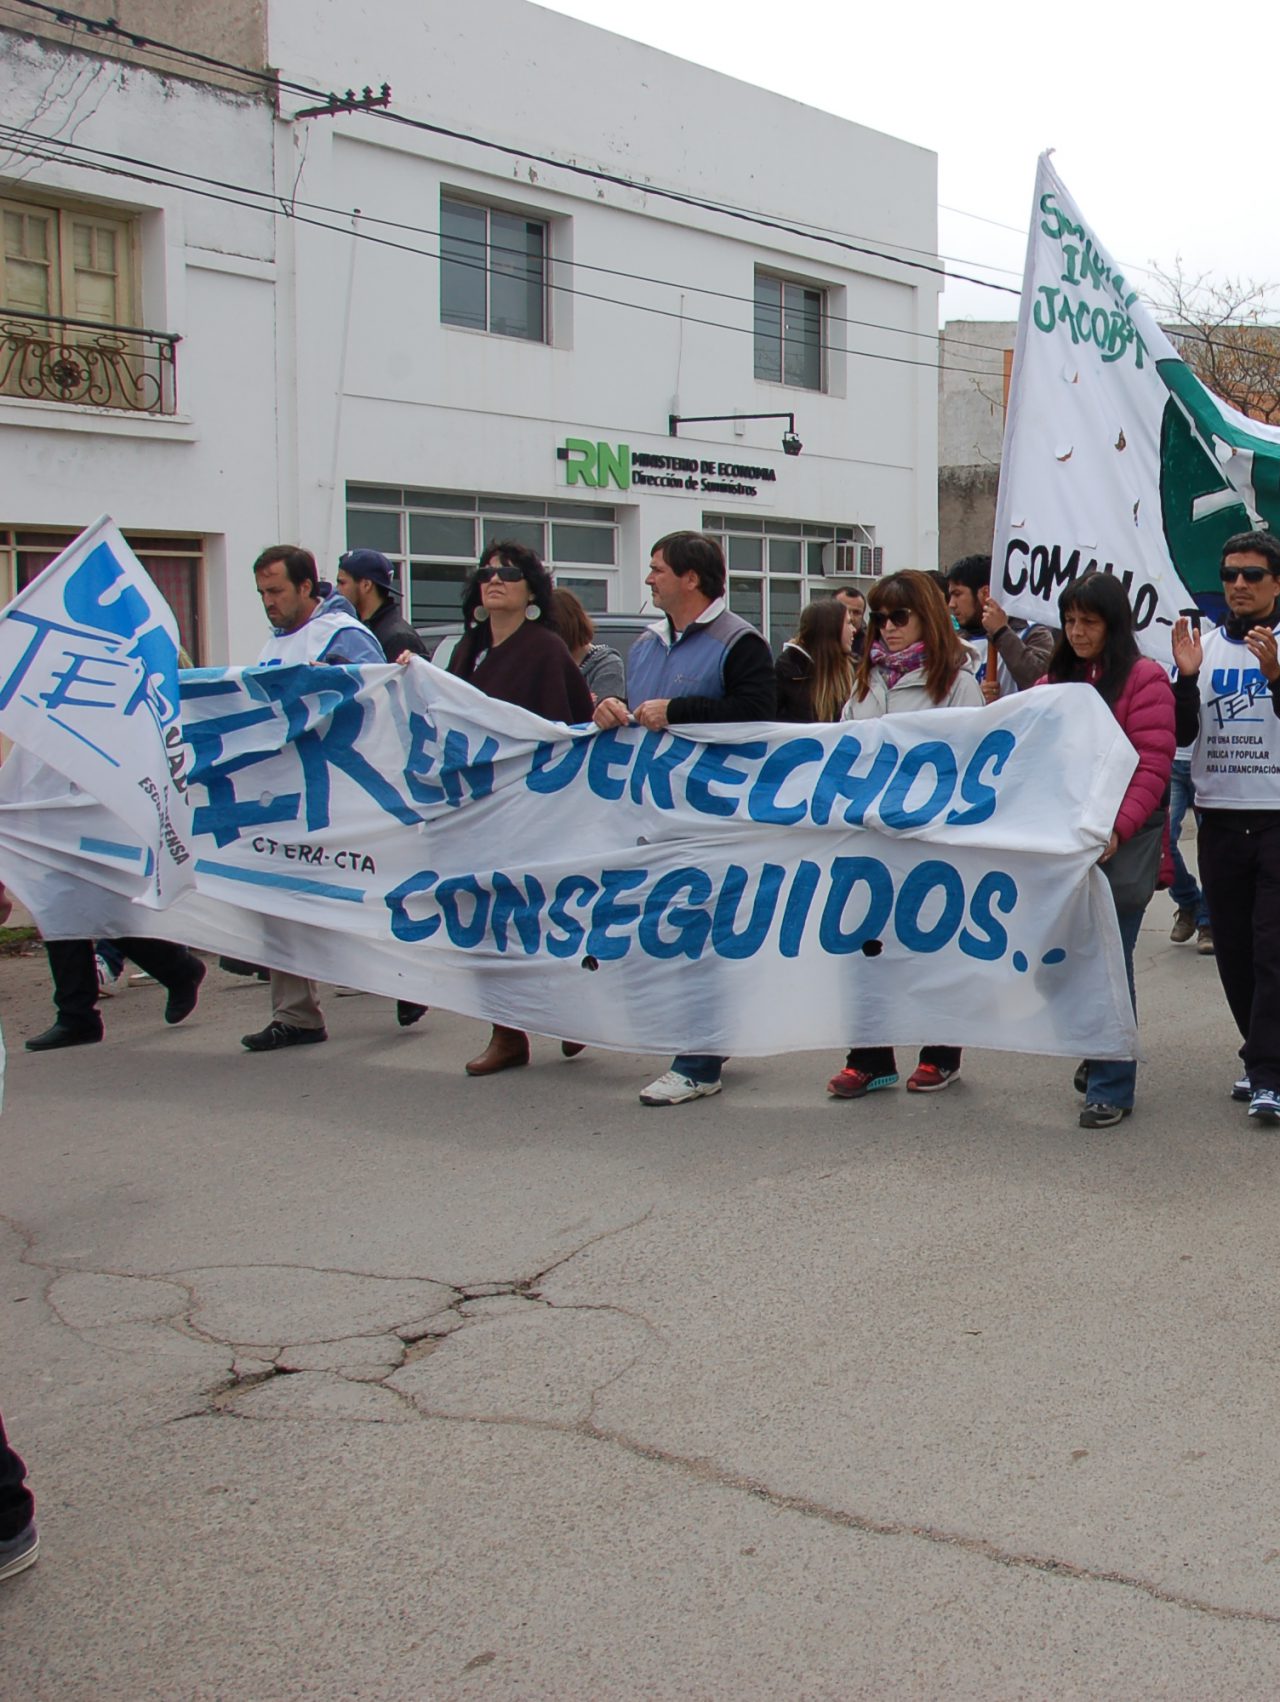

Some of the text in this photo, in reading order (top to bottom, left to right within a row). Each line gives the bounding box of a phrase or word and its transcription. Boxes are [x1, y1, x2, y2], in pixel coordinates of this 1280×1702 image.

[565, 437, 630, 490] RN
[631, 452, 699, 473] MINISTERIO
[700, 460, 716, 475] DE
[631, 470, 758, 497] Dirección de Suministros
[1231, 735, 1264, 745] ESCUELA
[1229, 751, 1235, 759] Y
[1235, 750, 1270, 760] POPULAR
[402, 710, 500, 808] EN
[525, 721, 1017, 830] DERECHOS
[1219, 765, 1228, 774] LA
